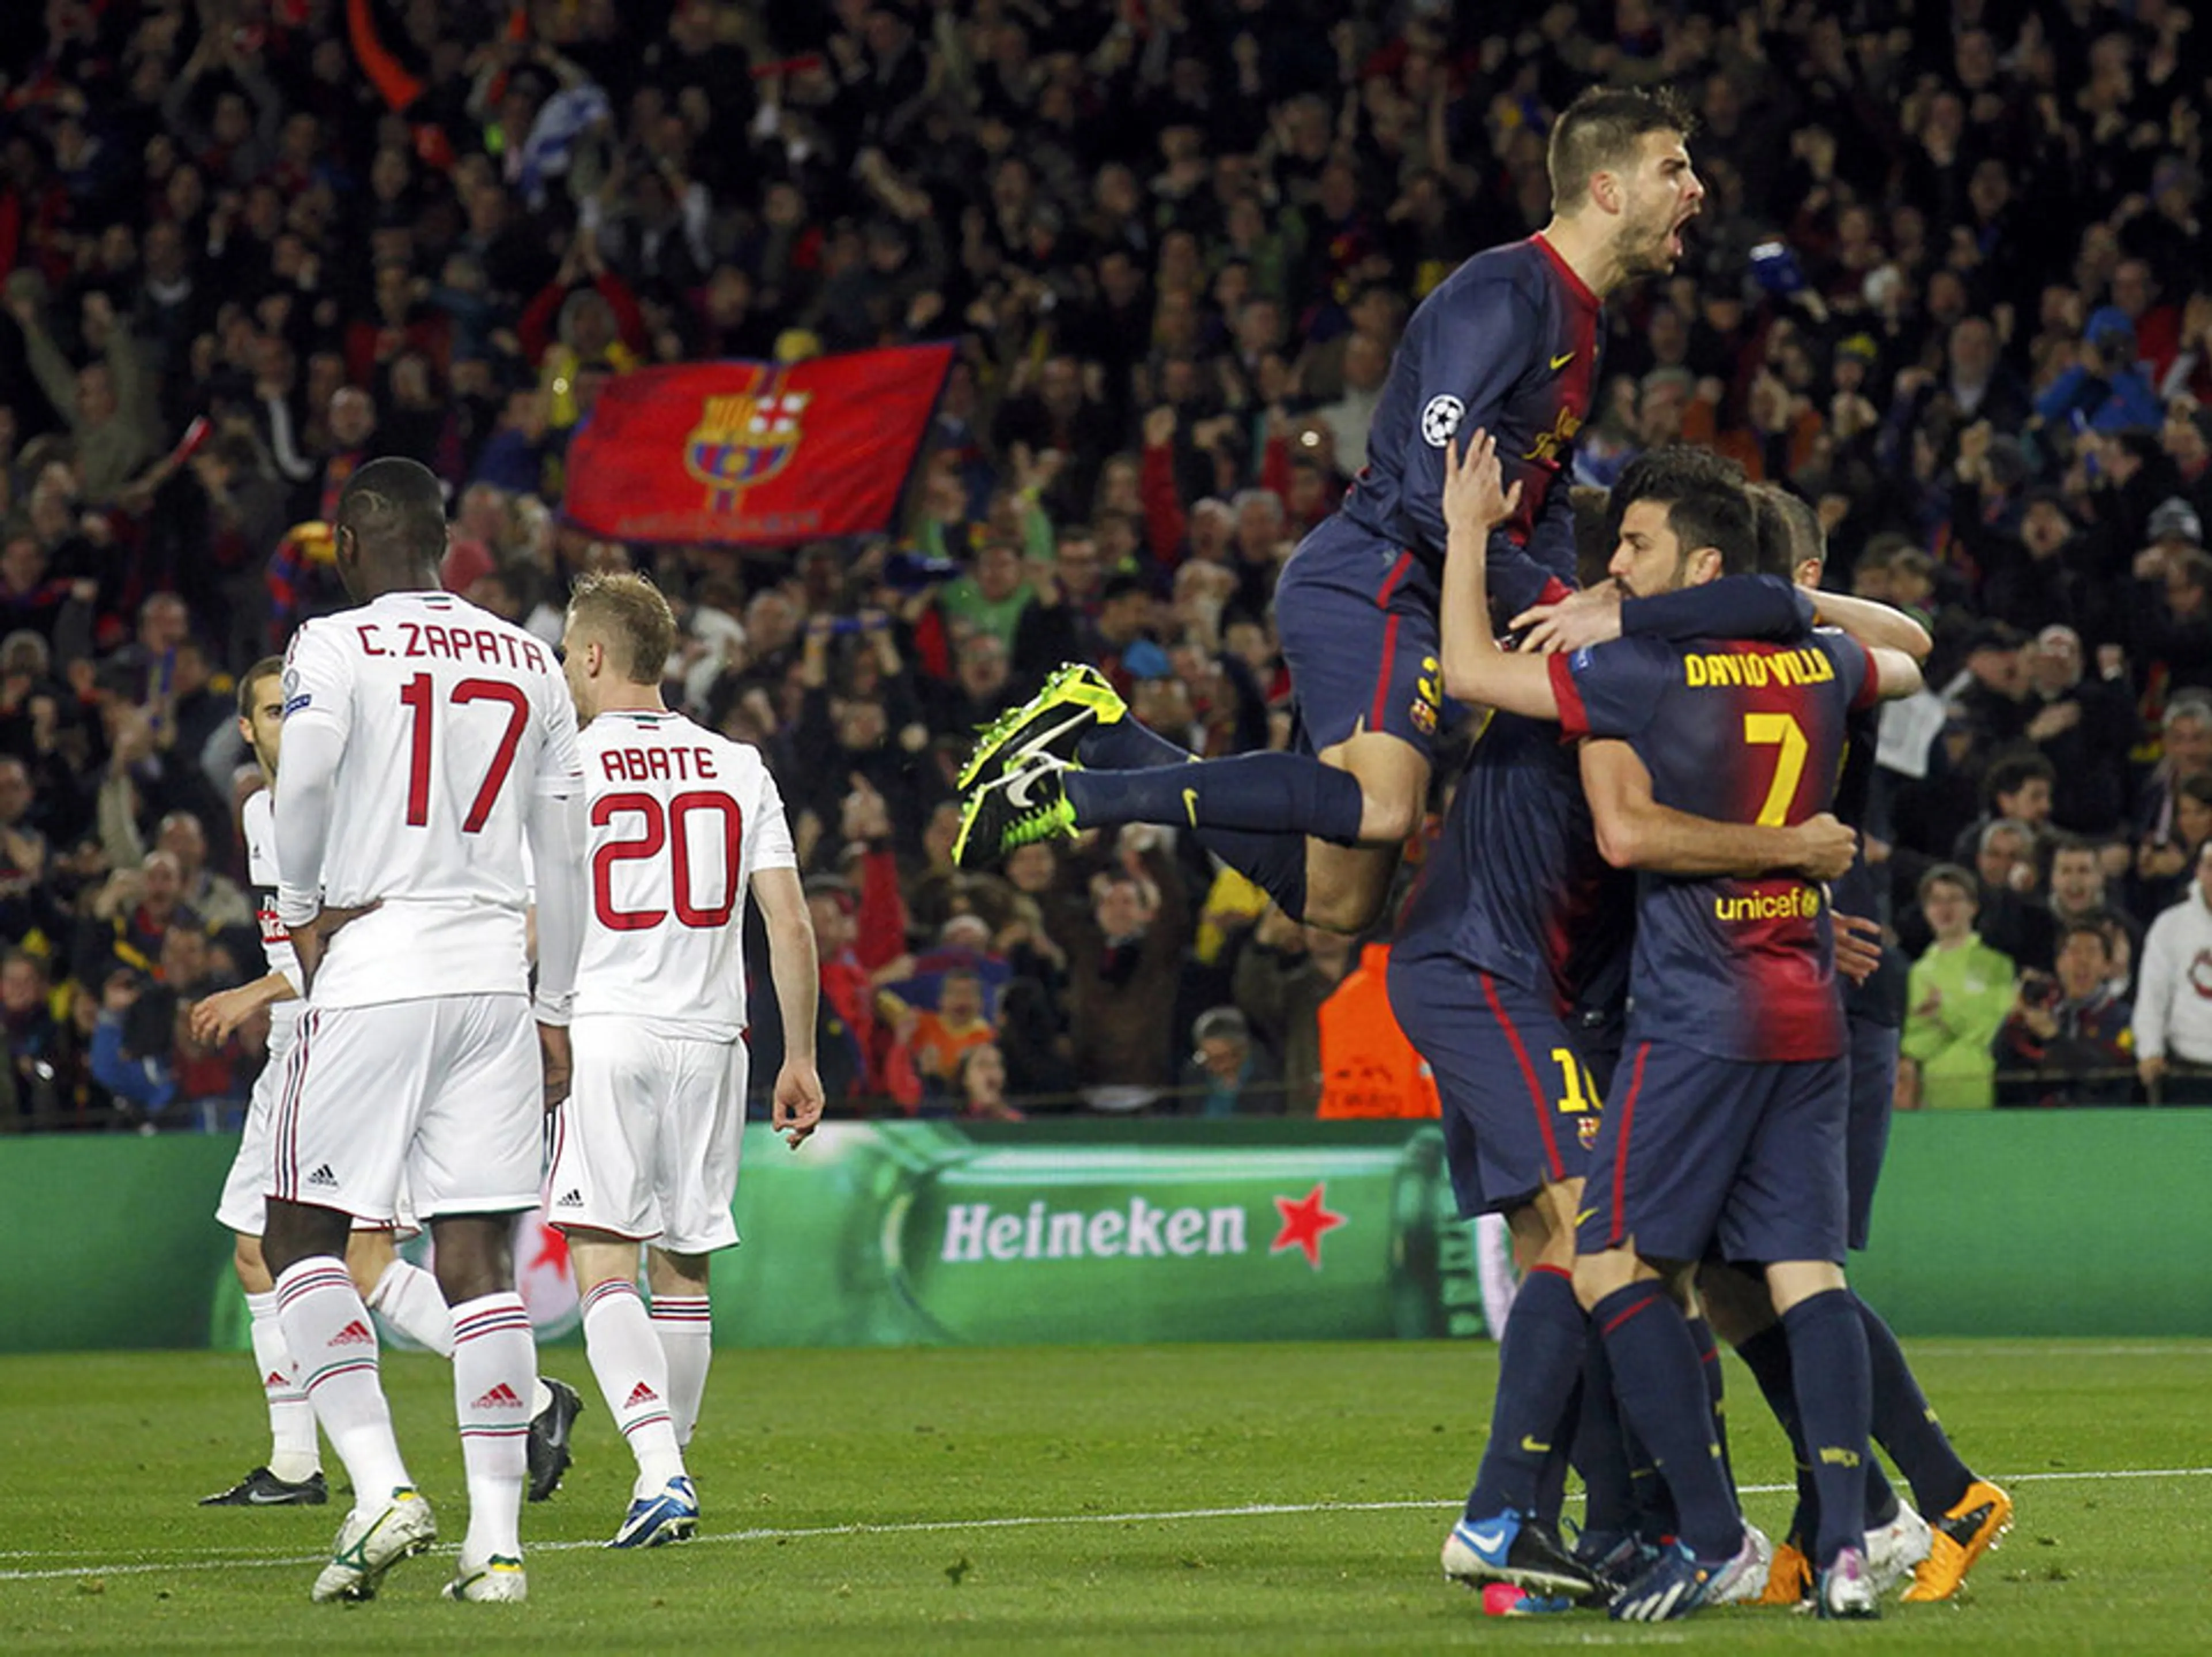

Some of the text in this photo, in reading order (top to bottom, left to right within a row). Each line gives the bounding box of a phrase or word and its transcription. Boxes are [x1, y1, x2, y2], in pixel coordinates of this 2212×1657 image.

[357, 623, 547, 674] C.ZAPATA
[1684, 647, 1835, 687] DAVID VILLA
[400, 672, 529, 833] 17
[601, 747, 717, 781] ABATE
[1744, 713, 1808, 826] 7
[592, 790, 742, 931] 20
[1715, 887, 1801, 920] unicef
[941, 1195, 1248, 1262] Heineken
